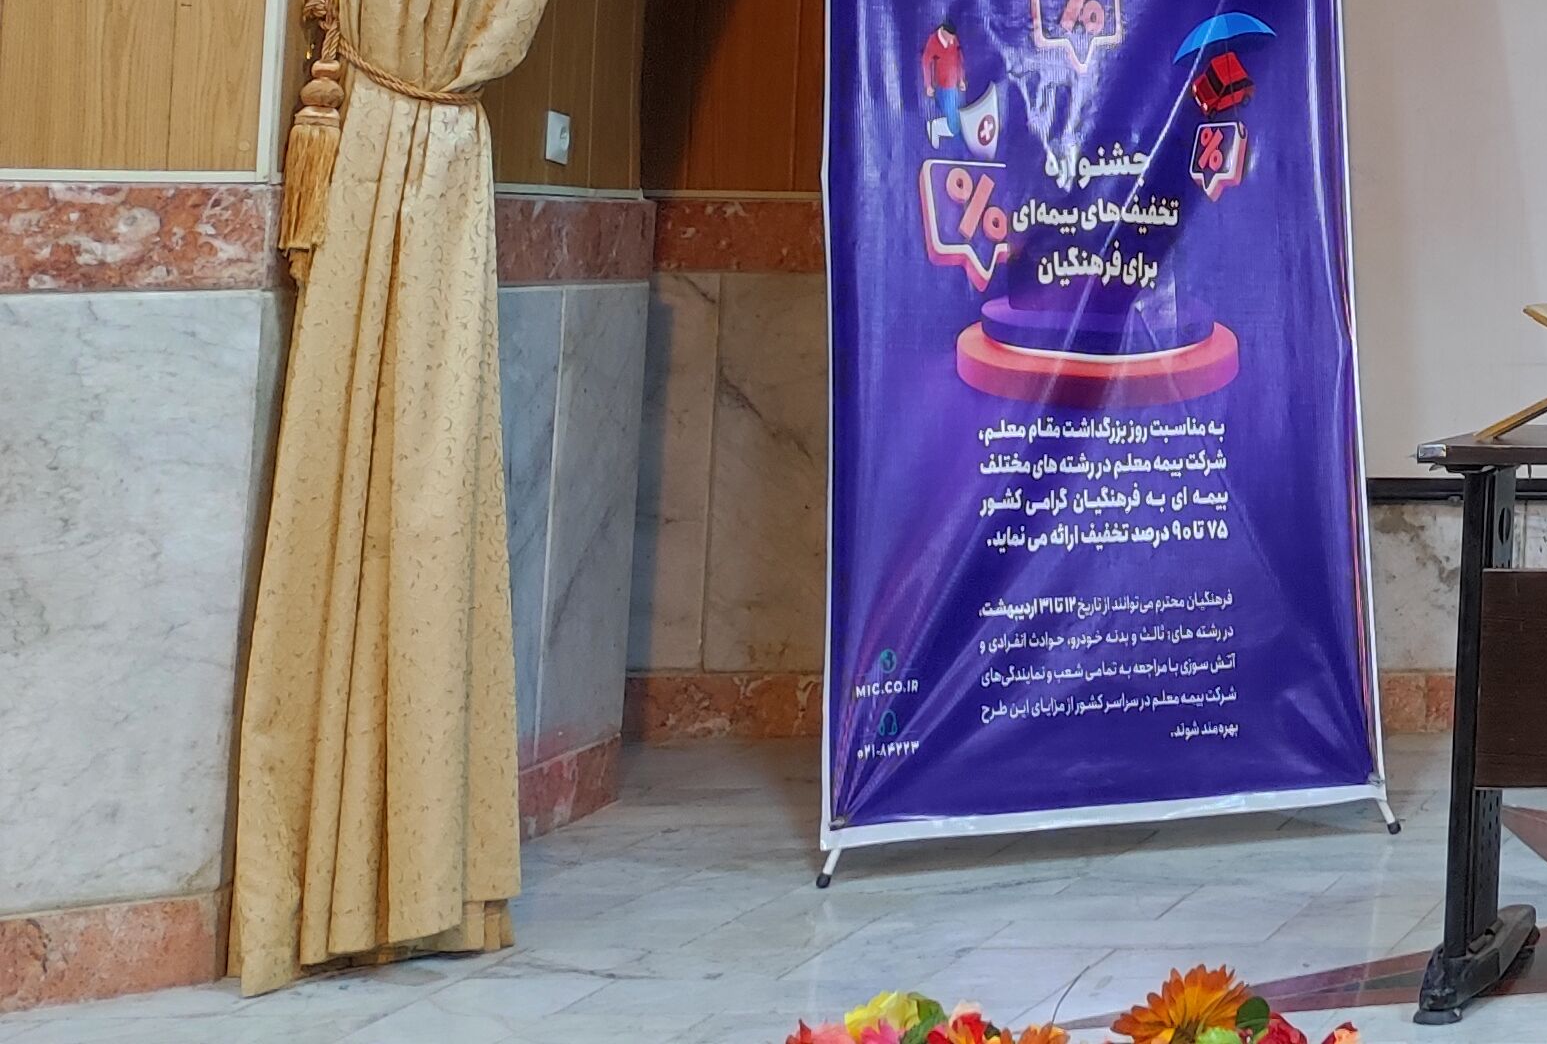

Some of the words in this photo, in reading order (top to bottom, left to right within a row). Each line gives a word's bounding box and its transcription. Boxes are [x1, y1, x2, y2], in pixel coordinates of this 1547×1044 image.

[1038, 239, 1121, 287] فرهنگیان
[1123, 252, 1157, 289] برای
[1028, 417, 1060, 443] مقام
[1063, 416, 1127, 444] بزرگداشت
[1127, 420, 1147, 443] روز
[1150, 417, 1206, 443] مناسبت
[1208, 421, 1225, 442] به
[980, 453, 1030, 474] مختلف
[1114, 453, 1151, 479] معلم
[1153, 456, 1183, 478] بیمه
[1186, 449, 1226, 476] شرکت
[980, 488, 1022, 517] کشور
[1026, 487, 1068, 516] گرامی
[1073, 482, 1140, 515] فرهنگیان
[1146, 491, 1166, 513] به
[1193, 489, 1228, 511] بیمه
[1081, 522, 1129, 551] تخفیف
[1131, 526, 1169, 548] درصد
[1207, 519, 1228, 539] ۷۵
[1155, 596, 1185, 613] محترم
[1187, 589, 1232, 610] فرهنگیان
[988, 633, 1026, 654] انفرادی
[1029, 632, 1064, 651] حوادث
[856, 680, 918, 698] MIC.CO.IR
[1180, 693, 1204, 707] بیمه
[1205, 686, 1237, 706] شرکت
[1152, 690, 1179, 711] معلم
[981, 700, 1007, 724] طرح
